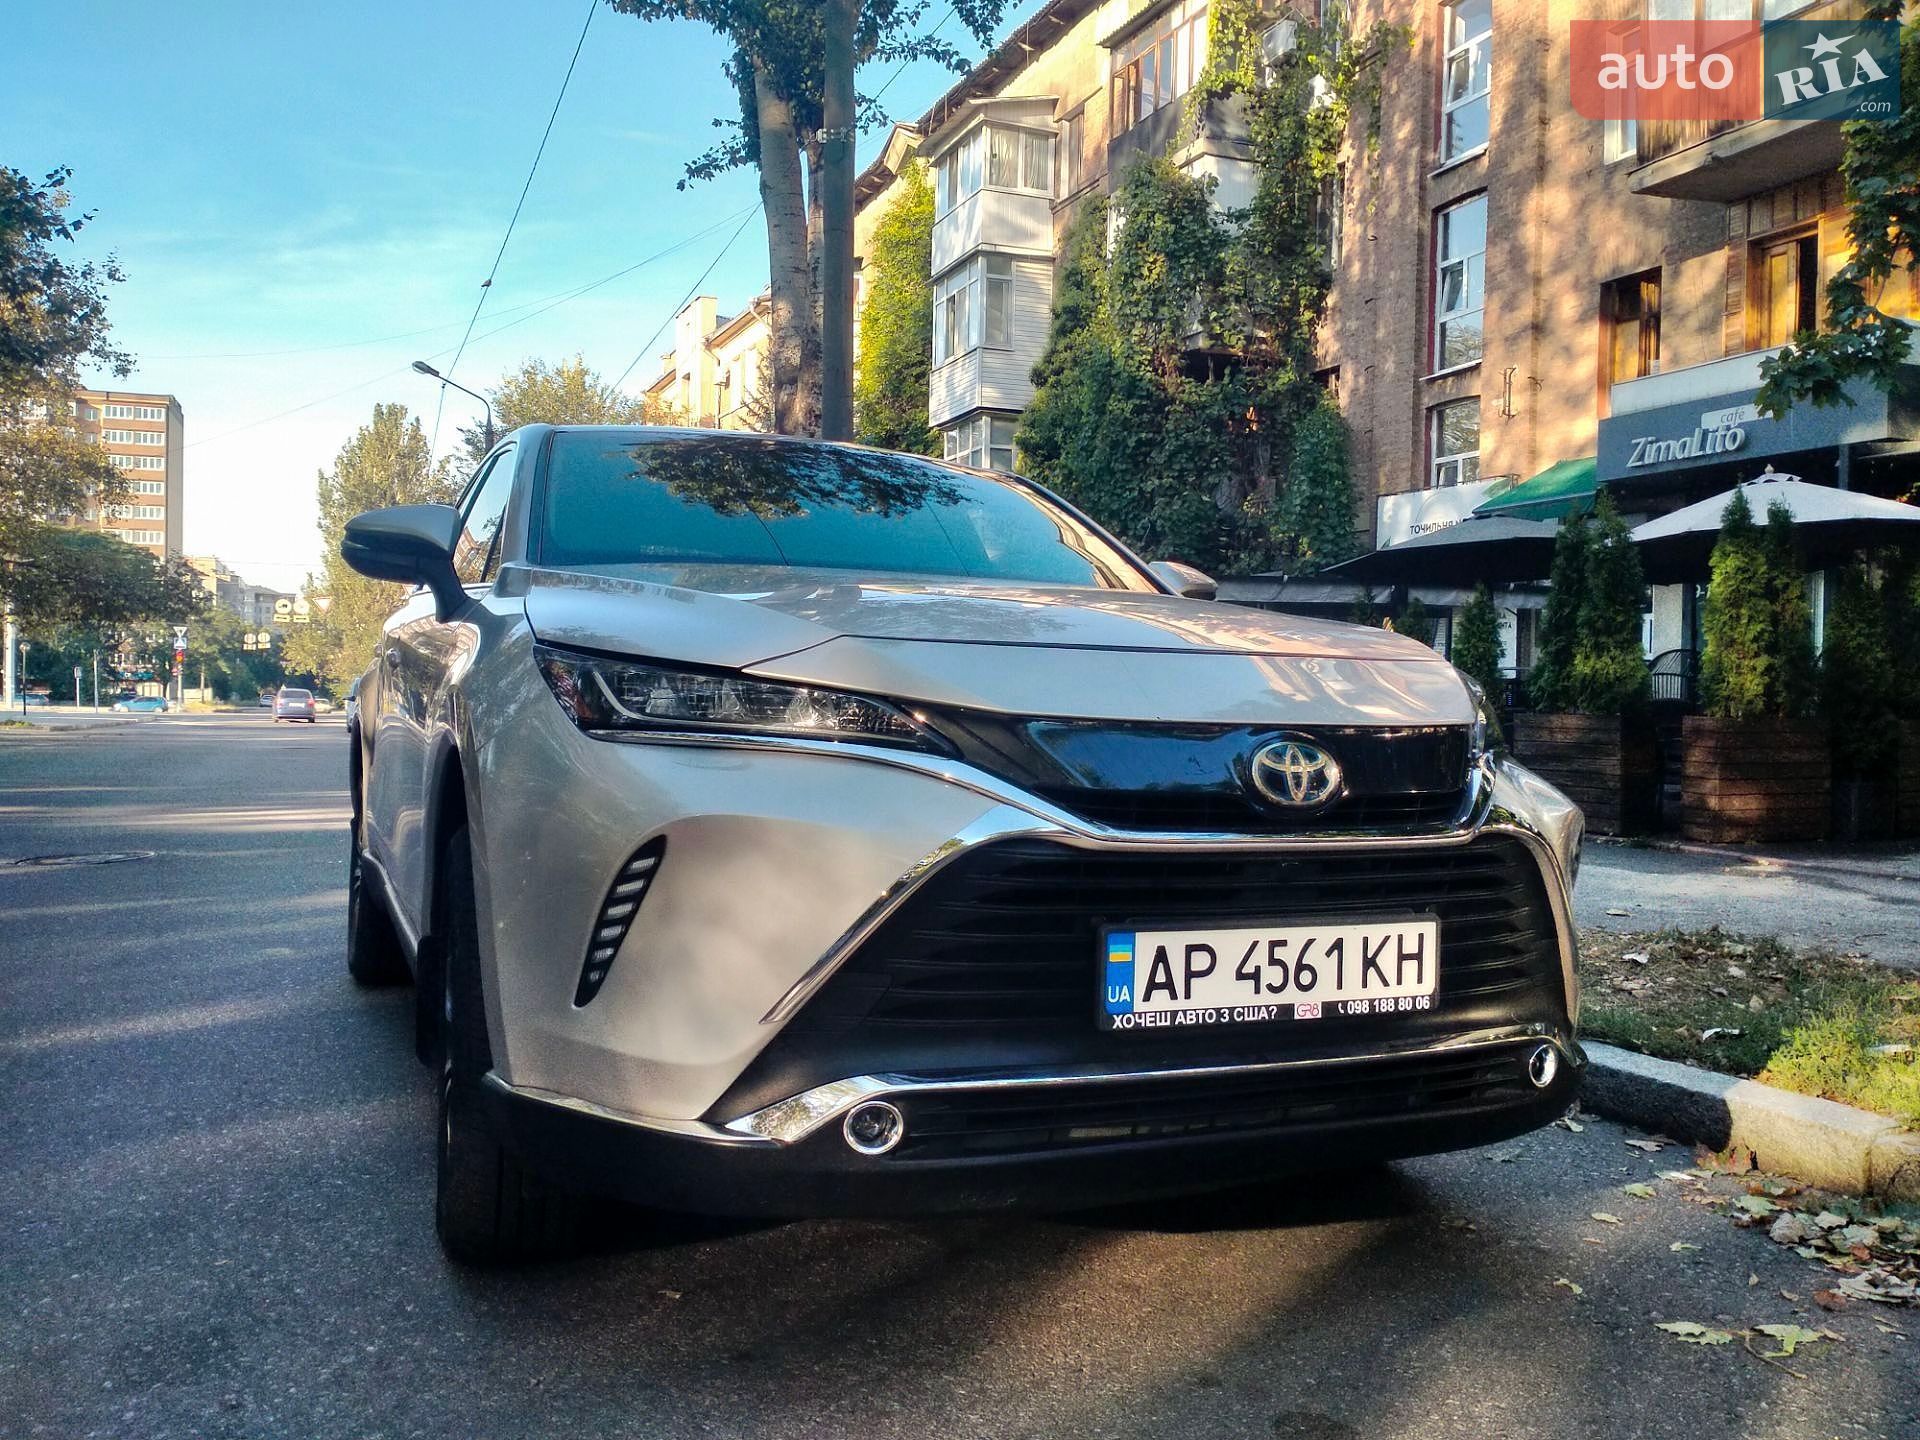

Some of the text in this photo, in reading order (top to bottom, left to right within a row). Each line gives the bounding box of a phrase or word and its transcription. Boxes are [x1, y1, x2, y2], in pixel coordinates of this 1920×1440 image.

[1720, 407, 1745, 426] café
[1625, 426, 1746, 467] ZimaLito
[1141, 932, 1425, 1003] AP 4561 KH
[1108, 984, 1131, 1004] UA
[1347, 996, 1430, 1014] 098 188 80 06
[1112, 1012, 1170, 1029] ХОЧЕШ
[1174, 1009, 1216, 1025] АВТО
[1233, 1005, 1278, 1022] США?
